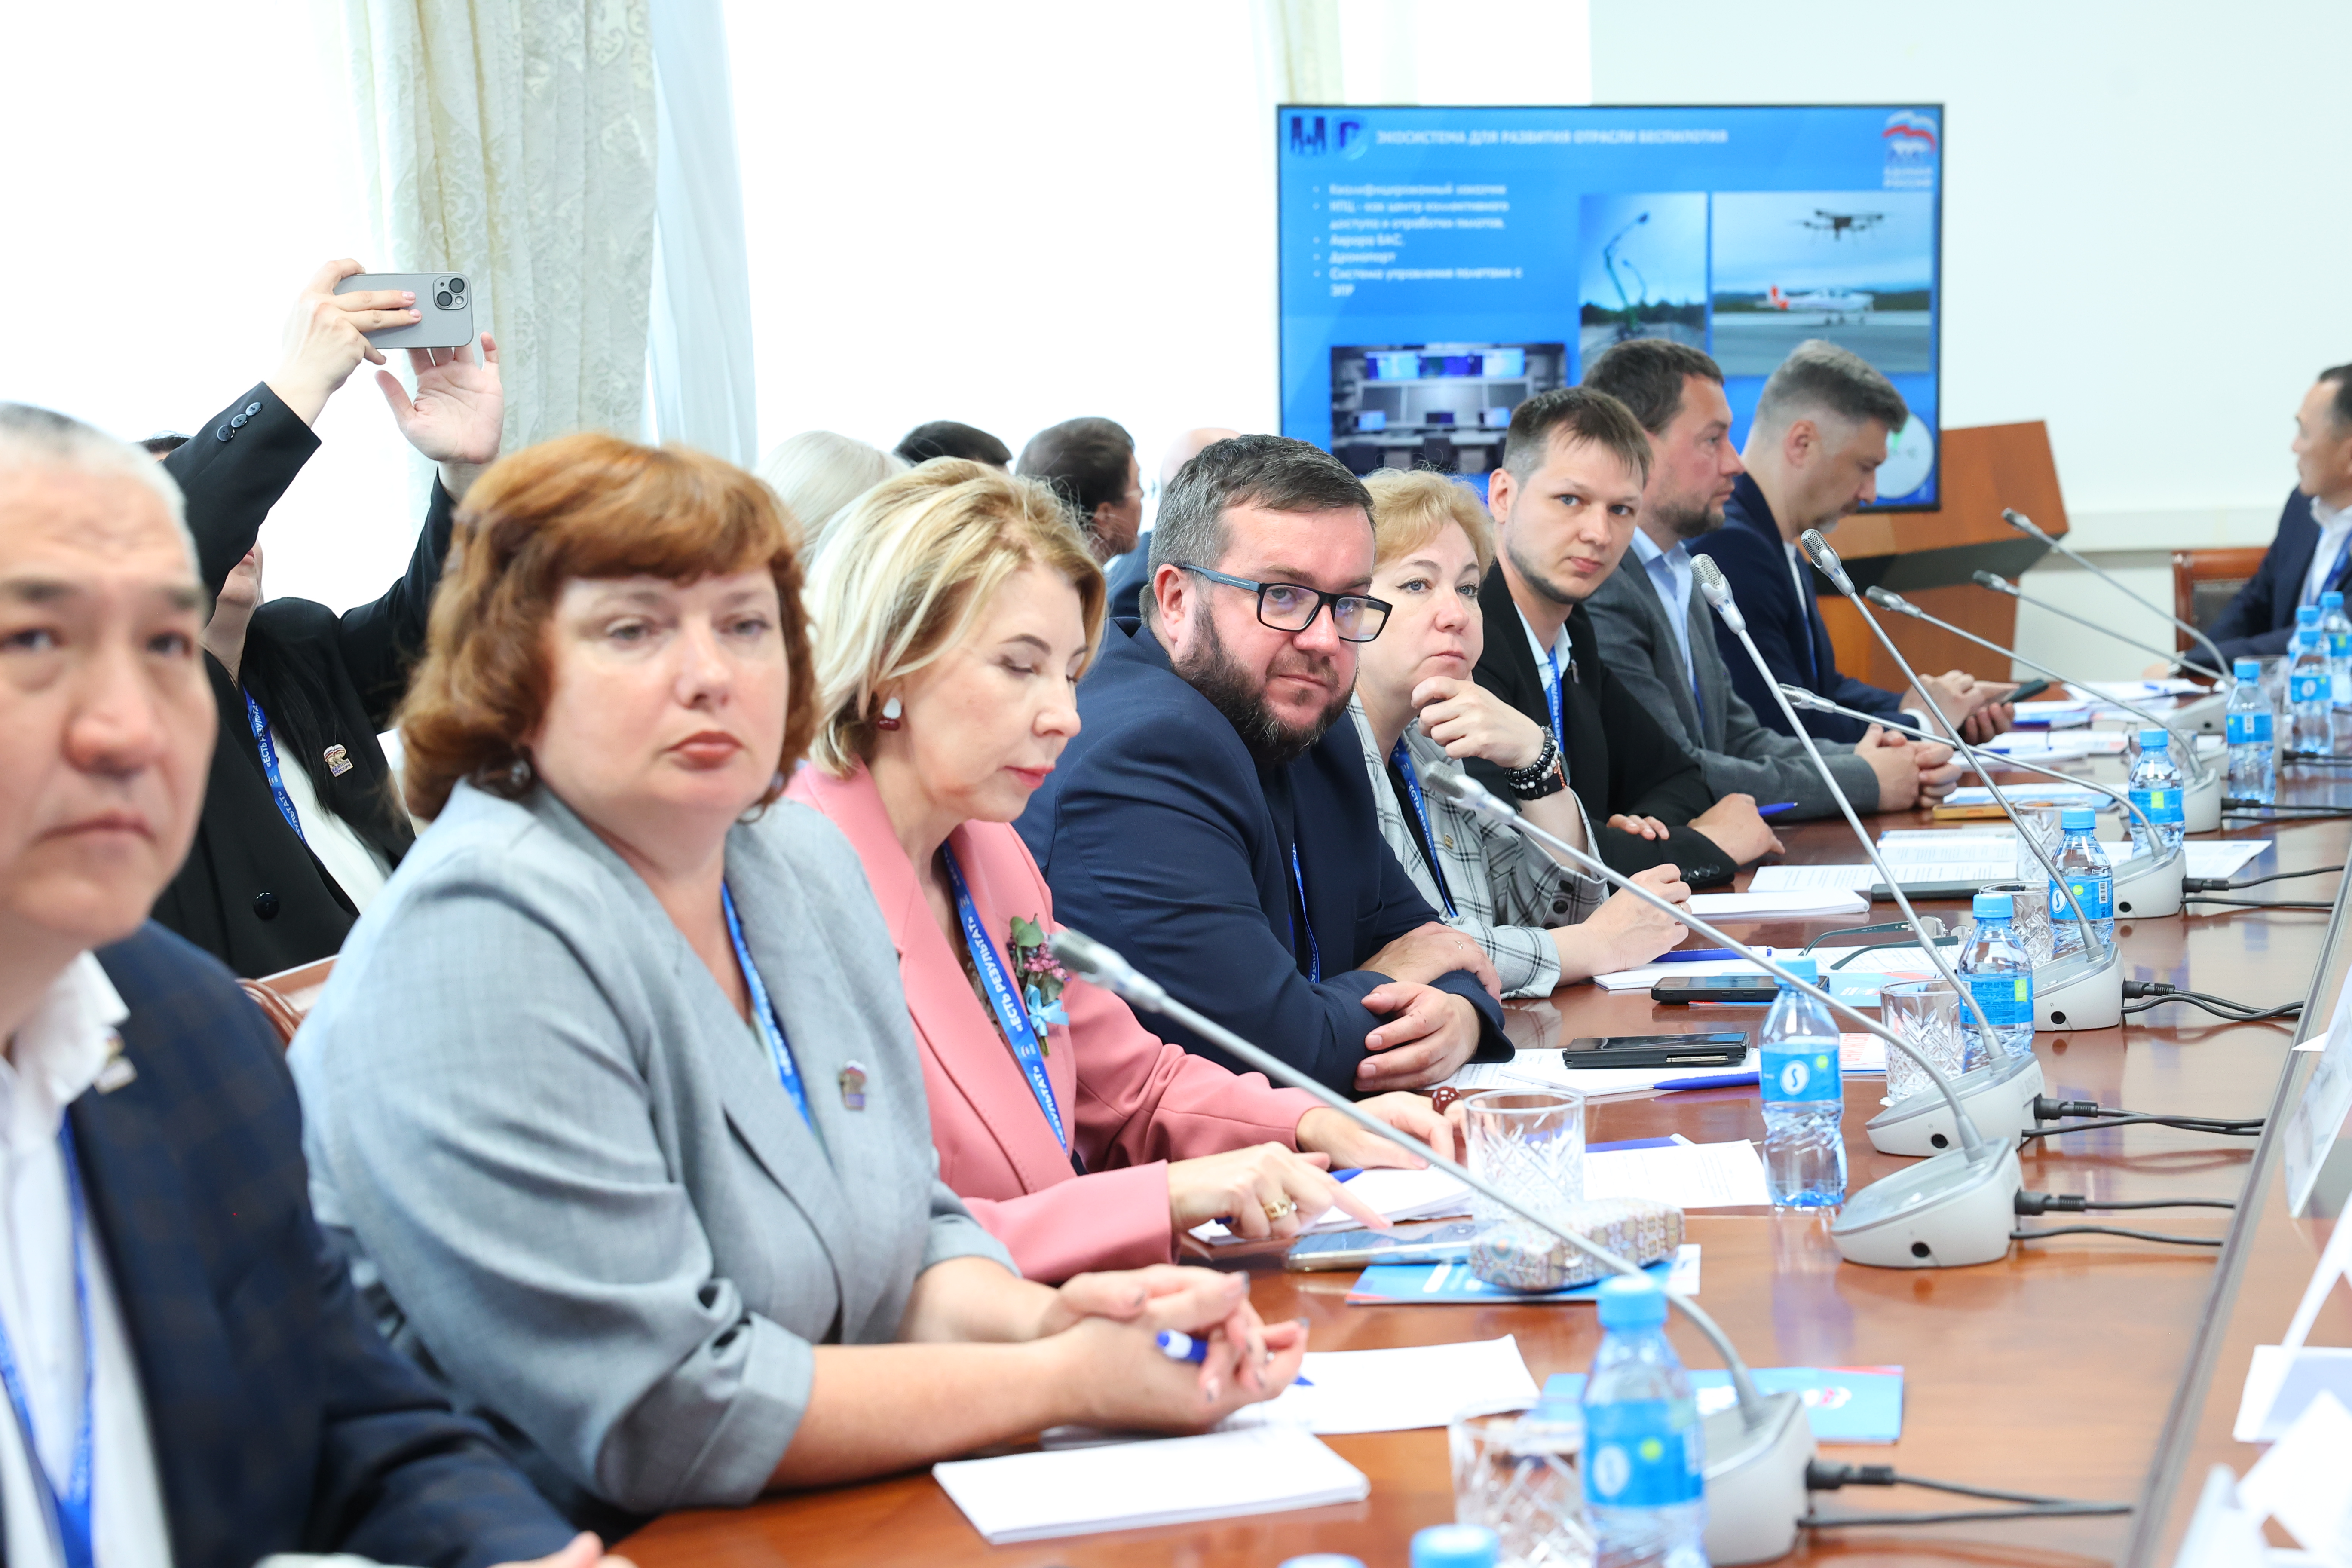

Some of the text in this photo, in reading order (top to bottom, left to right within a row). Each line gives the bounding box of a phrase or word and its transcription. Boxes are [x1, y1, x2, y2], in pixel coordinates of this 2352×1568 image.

[1376, 131, 1466, 144] ЭКОСИСТЕМА
[1468, 131, 1498, 145] ДЛЯ
[1501, 130, 1571, 144] РАЗВИТИЯ
[1574, 130, 1636, 144] ОТРАСЛИ
[1329, 267, 1384, 280] Система
[968, 916, 1023, 1032] «ЕСТЬ РЕЗУЛЬТАТ»
